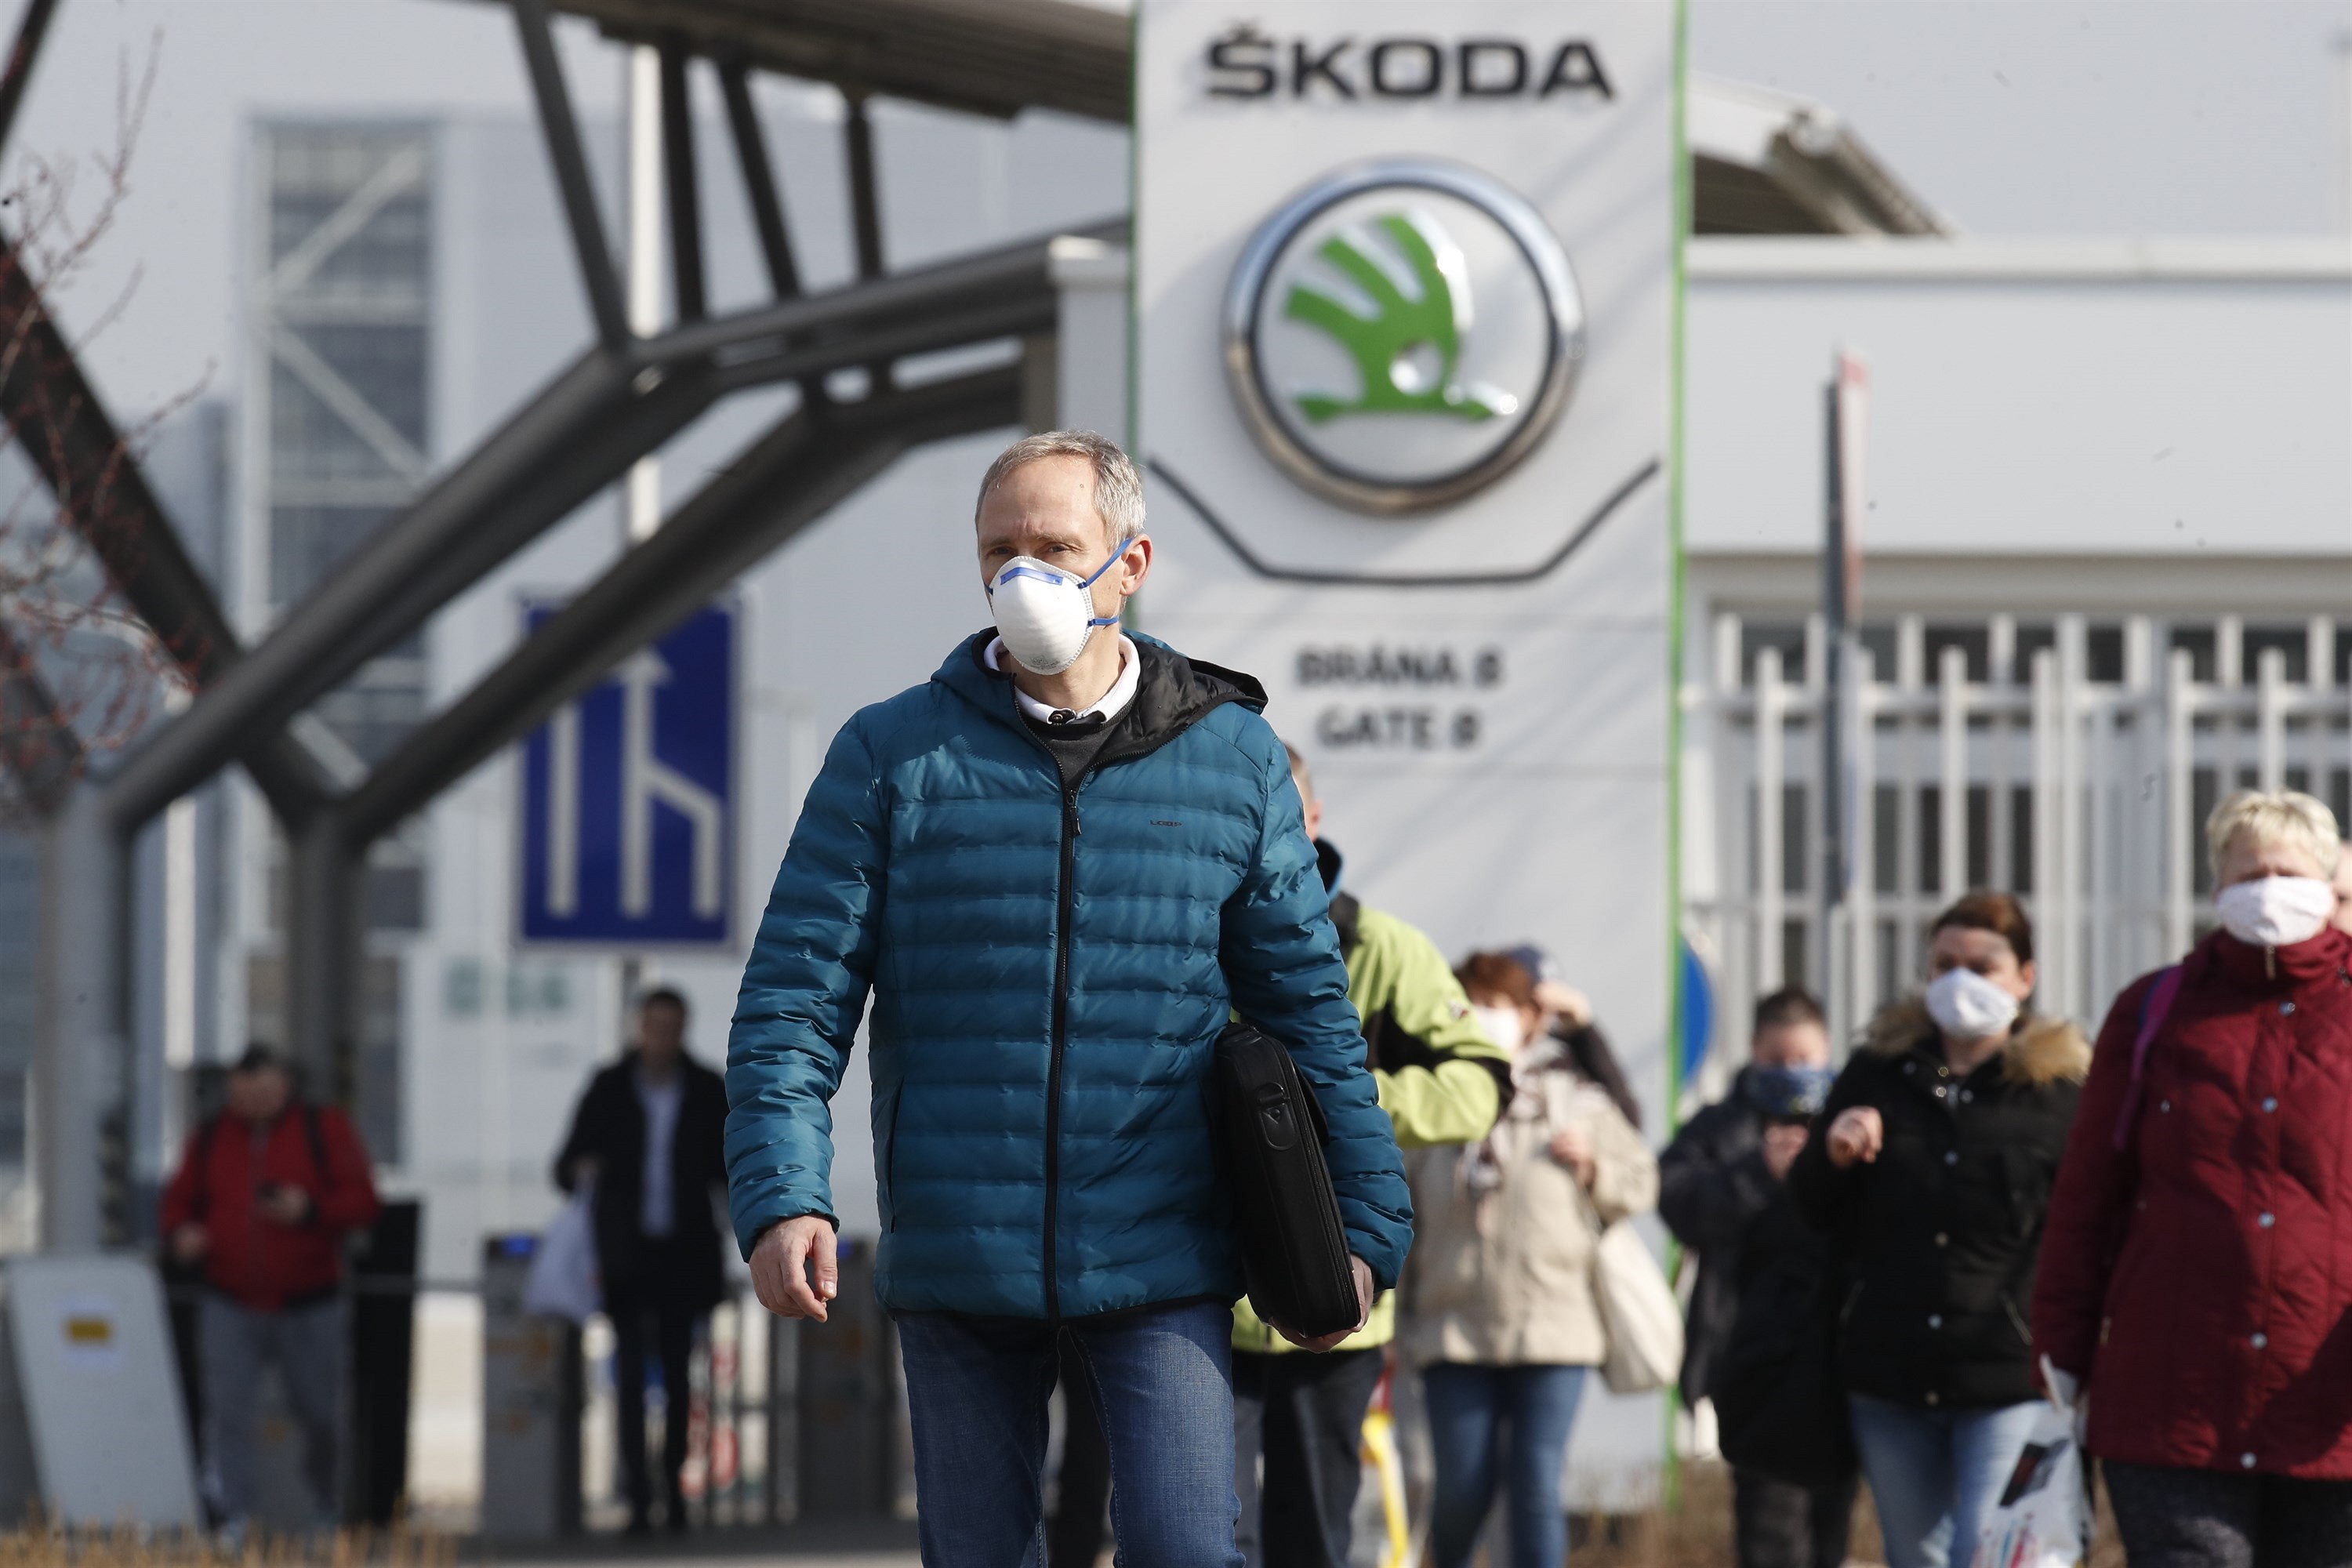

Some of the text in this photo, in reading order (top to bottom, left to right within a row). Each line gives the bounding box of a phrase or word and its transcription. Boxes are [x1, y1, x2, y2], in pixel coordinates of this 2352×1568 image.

[1205, 22, 1615, 100] ŠKODA
[1294, 641, 1460, 687] BRÁNA
[1316, 708, 1436, 747] GATE
